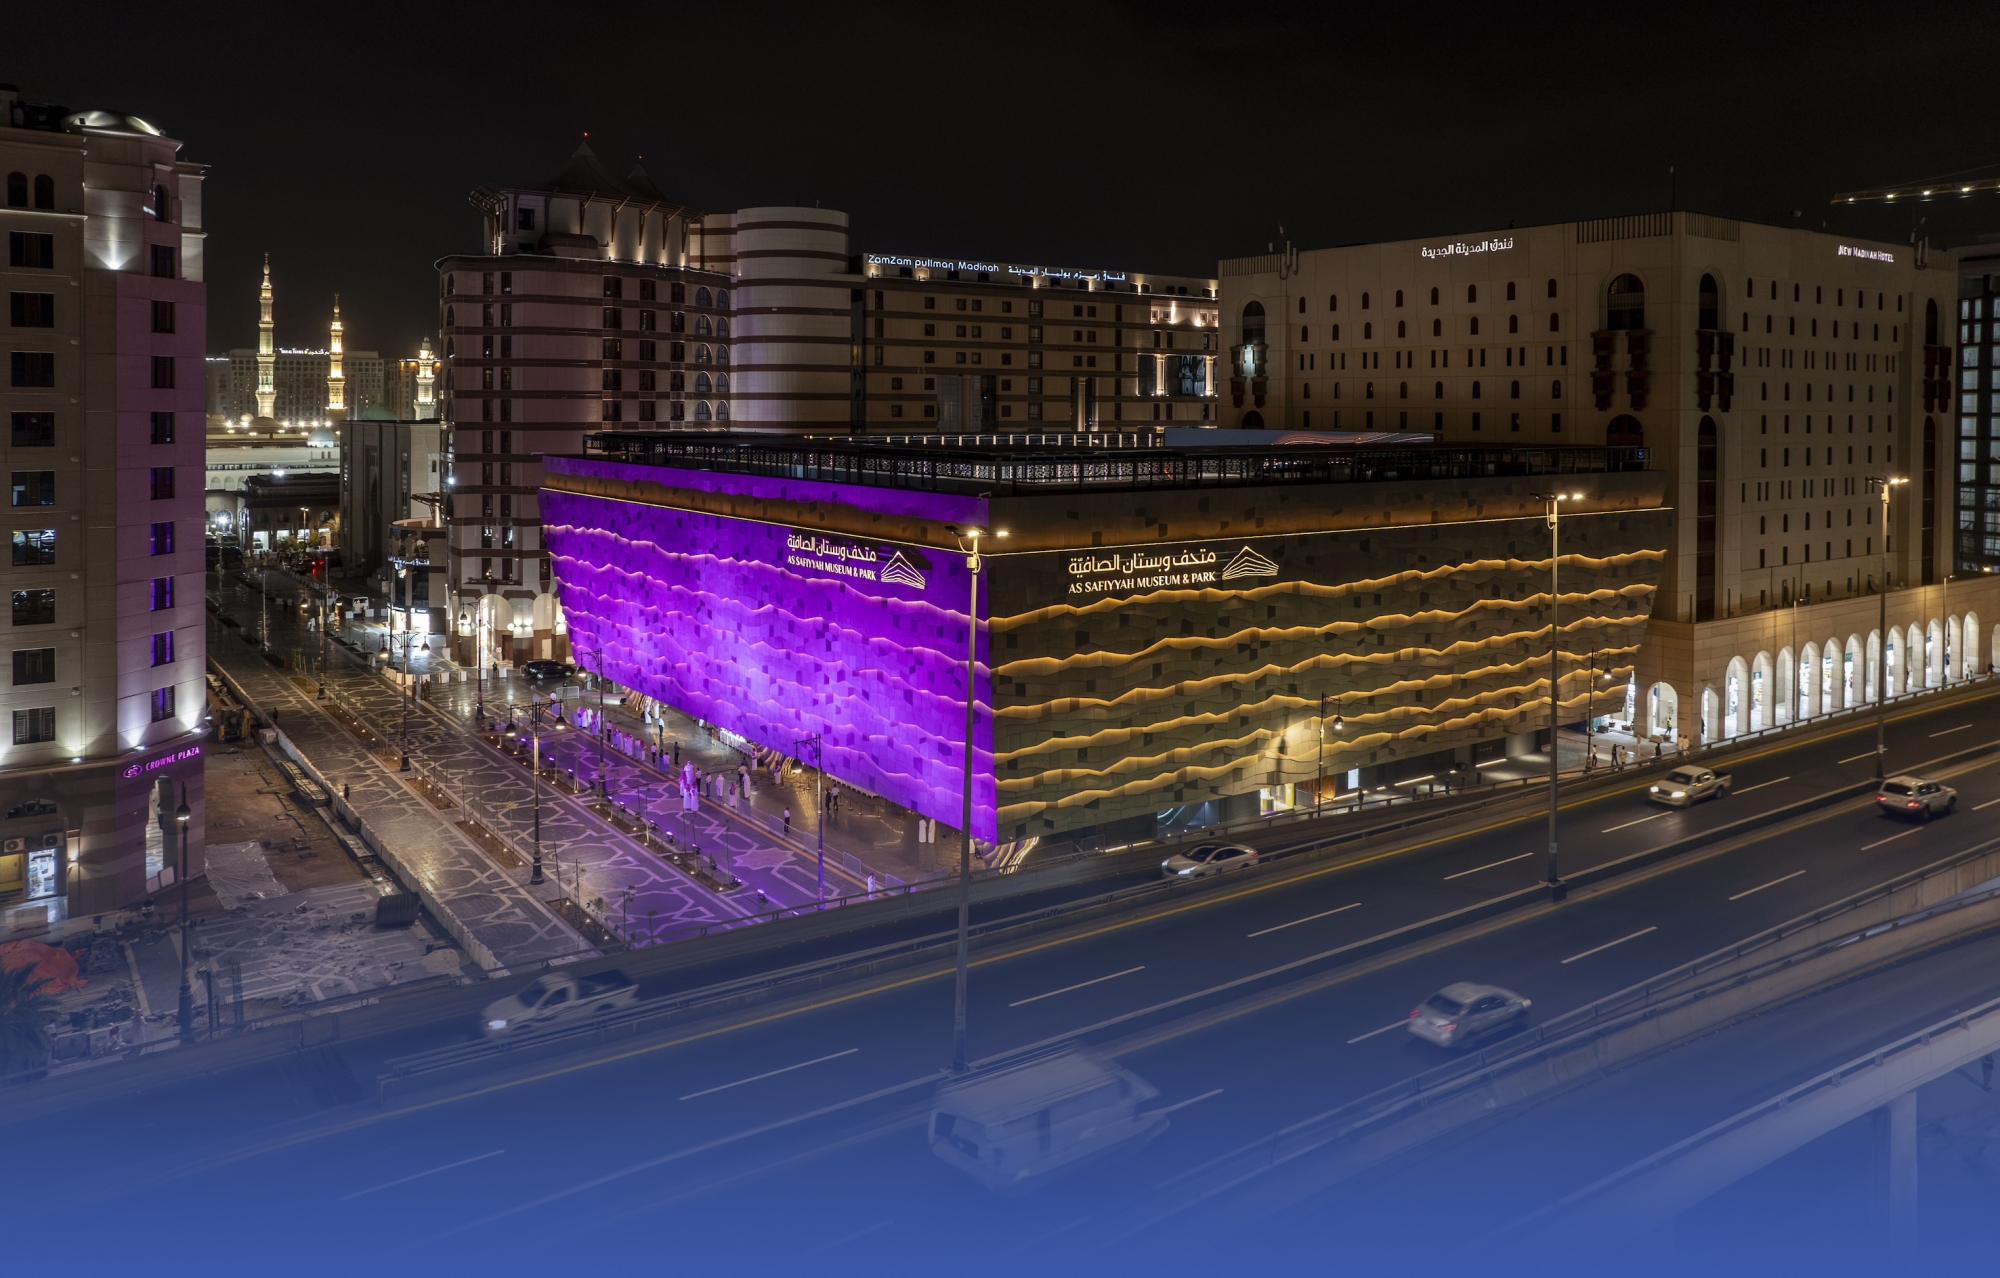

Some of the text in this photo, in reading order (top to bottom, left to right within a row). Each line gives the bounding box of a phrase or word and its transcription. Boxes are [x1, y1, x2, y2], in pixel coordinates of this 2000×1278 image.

[1421, 237, 1513, 258] فندق المدينة الجديدة
[1878, 251, 1894, 262] HOTEL
[868, 254, 999, 272] ZamZam pullman Madinah
[1008, 265, 1038, 276] المدينة
[1073, 270, 1101, 281] زمزم
[1102, 270, 1126, 281] فندق
[816, 538, 845, 561] وبستان
[846, 545, 877, 562] متحف
[1172, 548, 1216, 566] متحف
[787, 555, 877, 581] AS SAFIYYAH MUSEUM & PARK
[1122, 552, 1171, 573] وبستان
[1068, 571, 1216, 594] AS SAFIYYAH MUSEUM & PARK
[145, 746, 200, 770] CROWNE PLAZA
